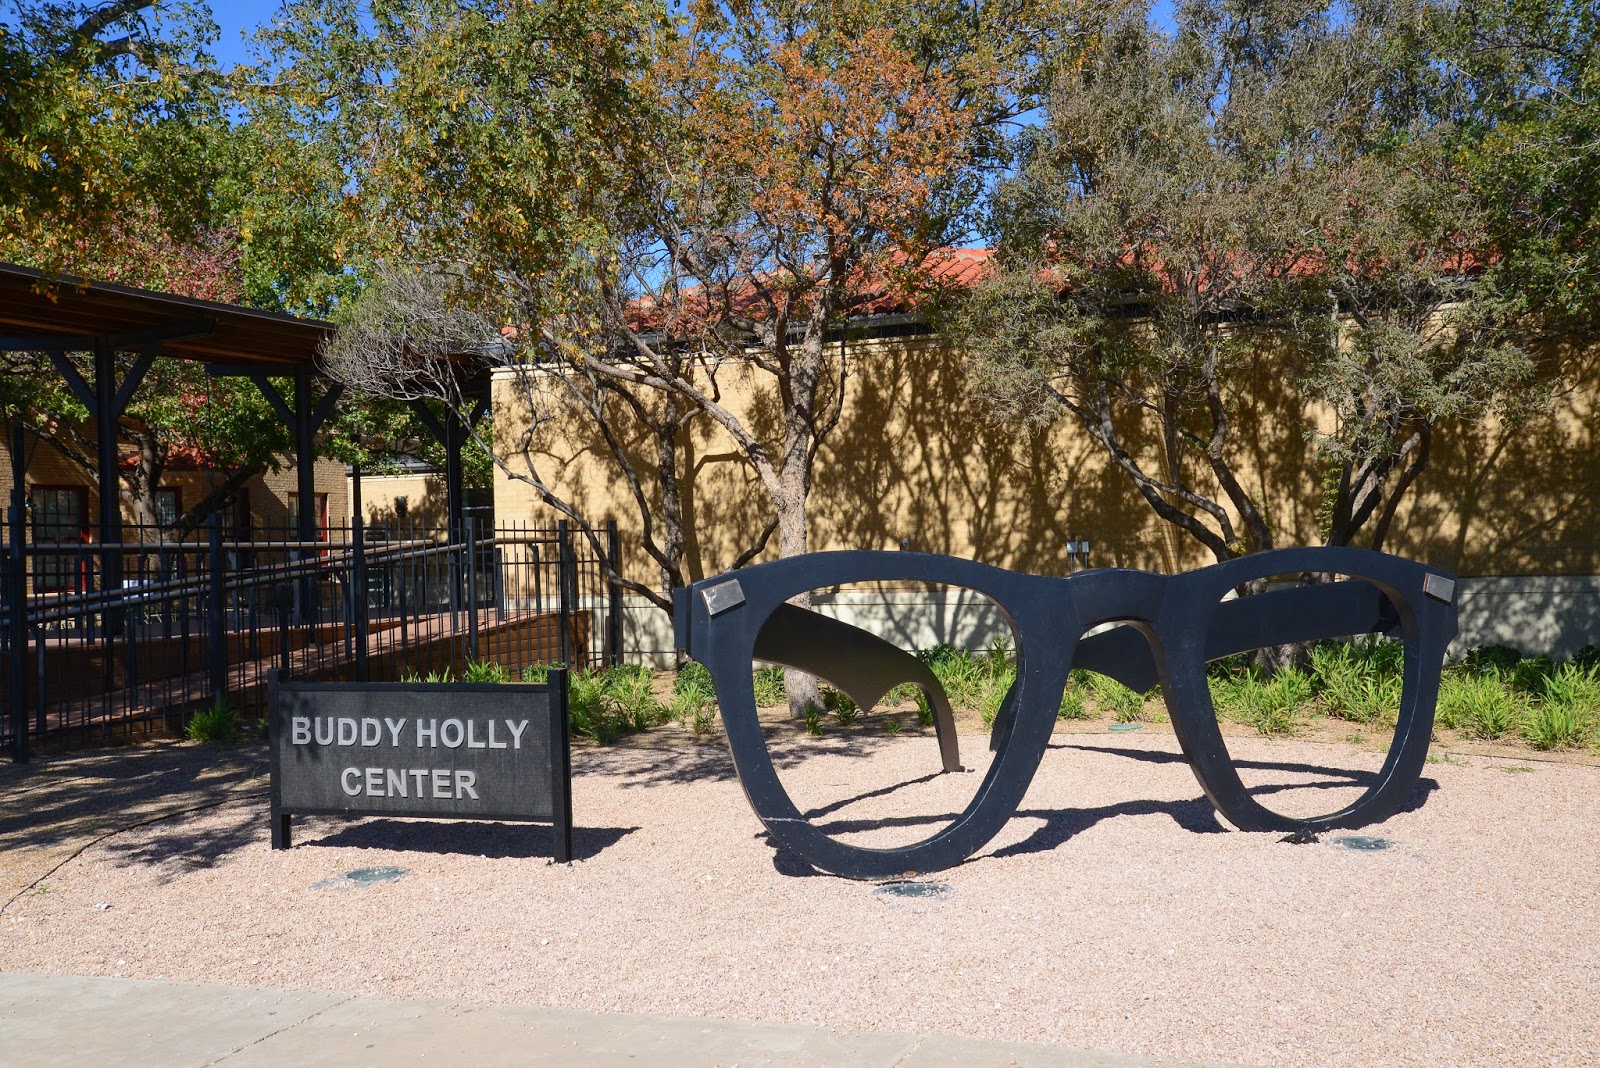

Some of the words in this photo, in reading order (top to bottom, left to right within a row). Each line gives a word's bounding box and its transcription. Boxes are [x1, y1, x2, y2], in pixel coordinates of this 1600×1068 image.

[291, 716, 407, 747] BUDDY
[416, 718, 529, 749] HOLLY
[340, 767, 479, 800] CENTER
